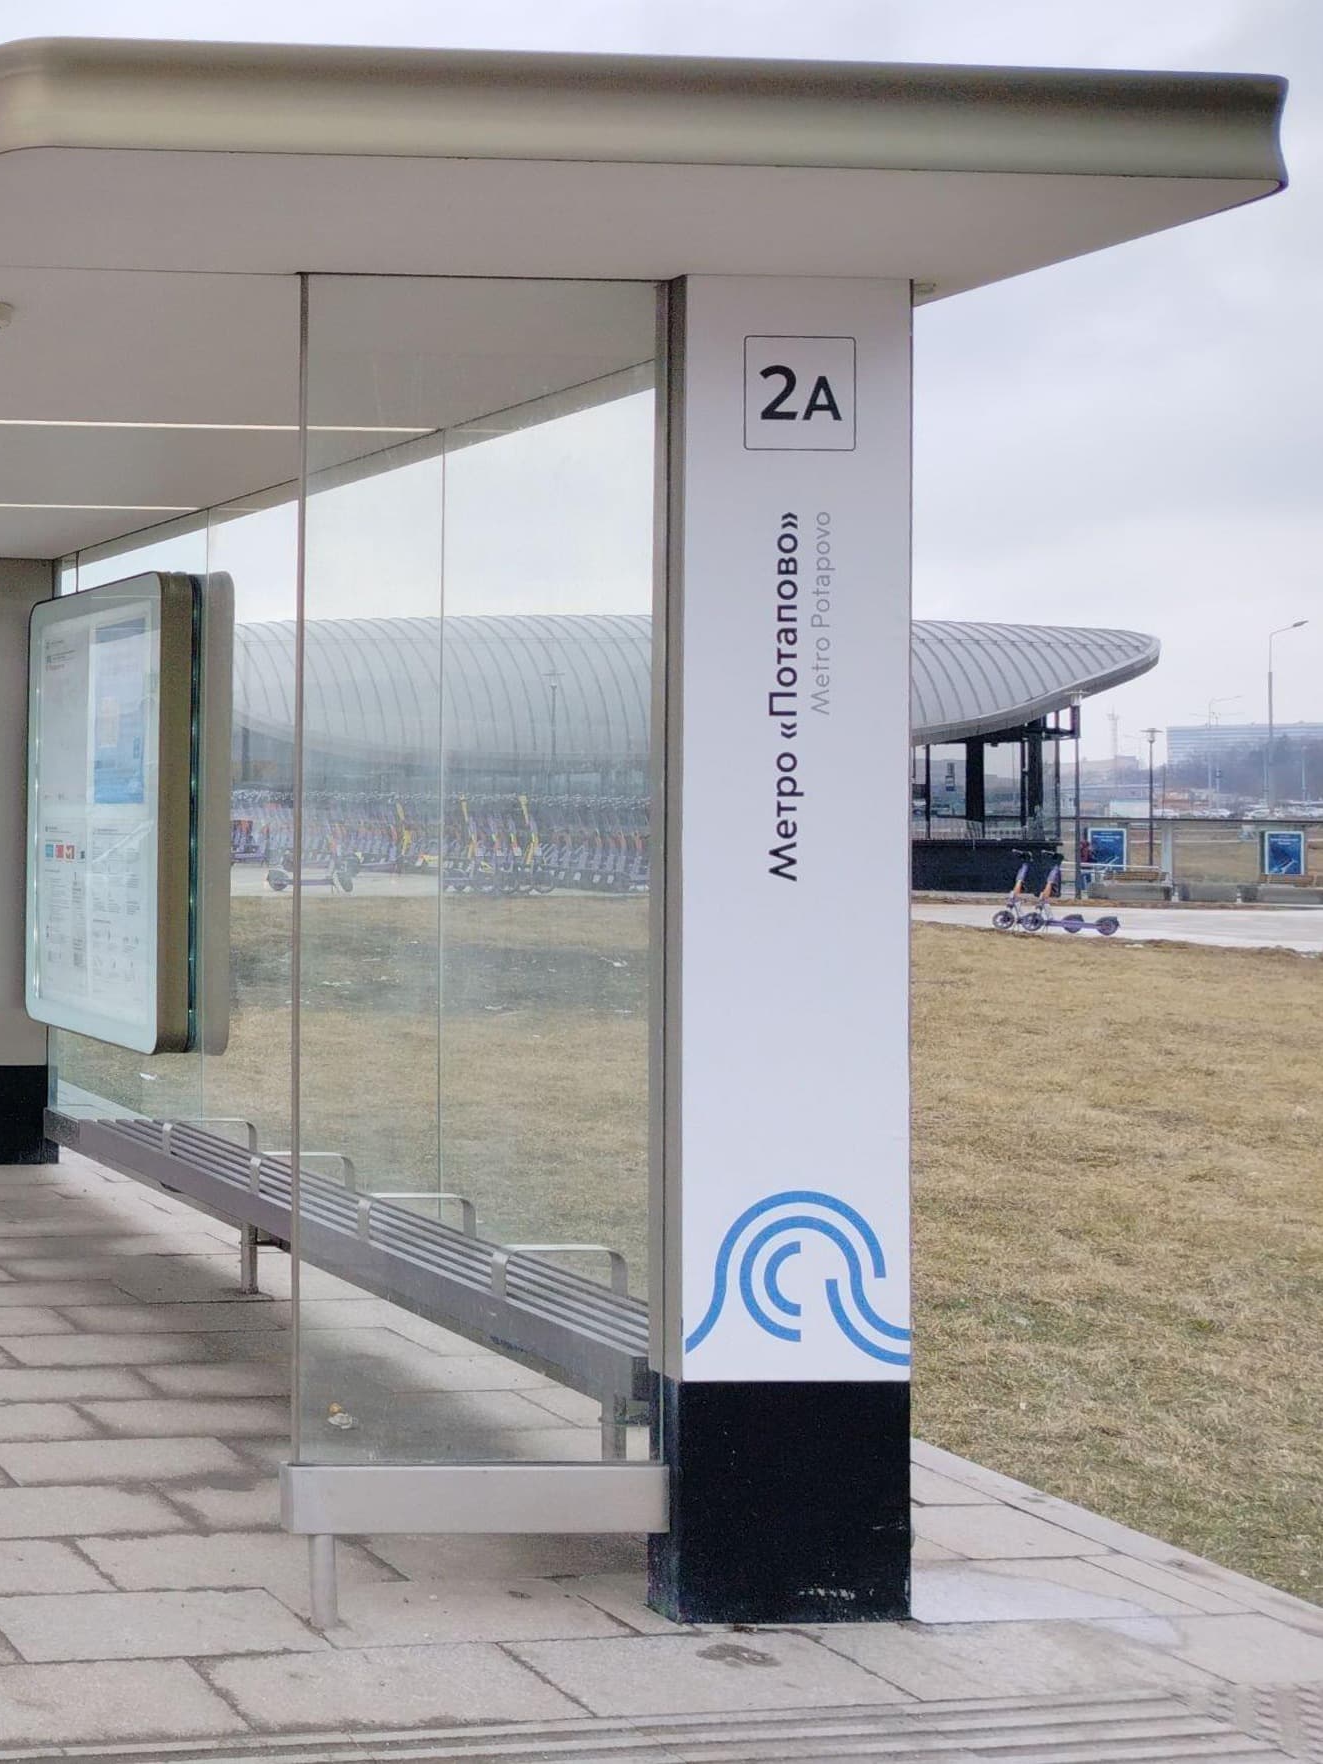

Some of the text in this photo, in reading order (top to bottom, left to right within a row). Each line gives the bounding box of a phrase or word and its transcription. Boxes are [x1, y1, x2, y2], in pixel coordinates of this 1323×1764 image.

[768, 510, 805, 882] Метро «Потапово»
[810, 511, 836, 716] Metro Potapovo
